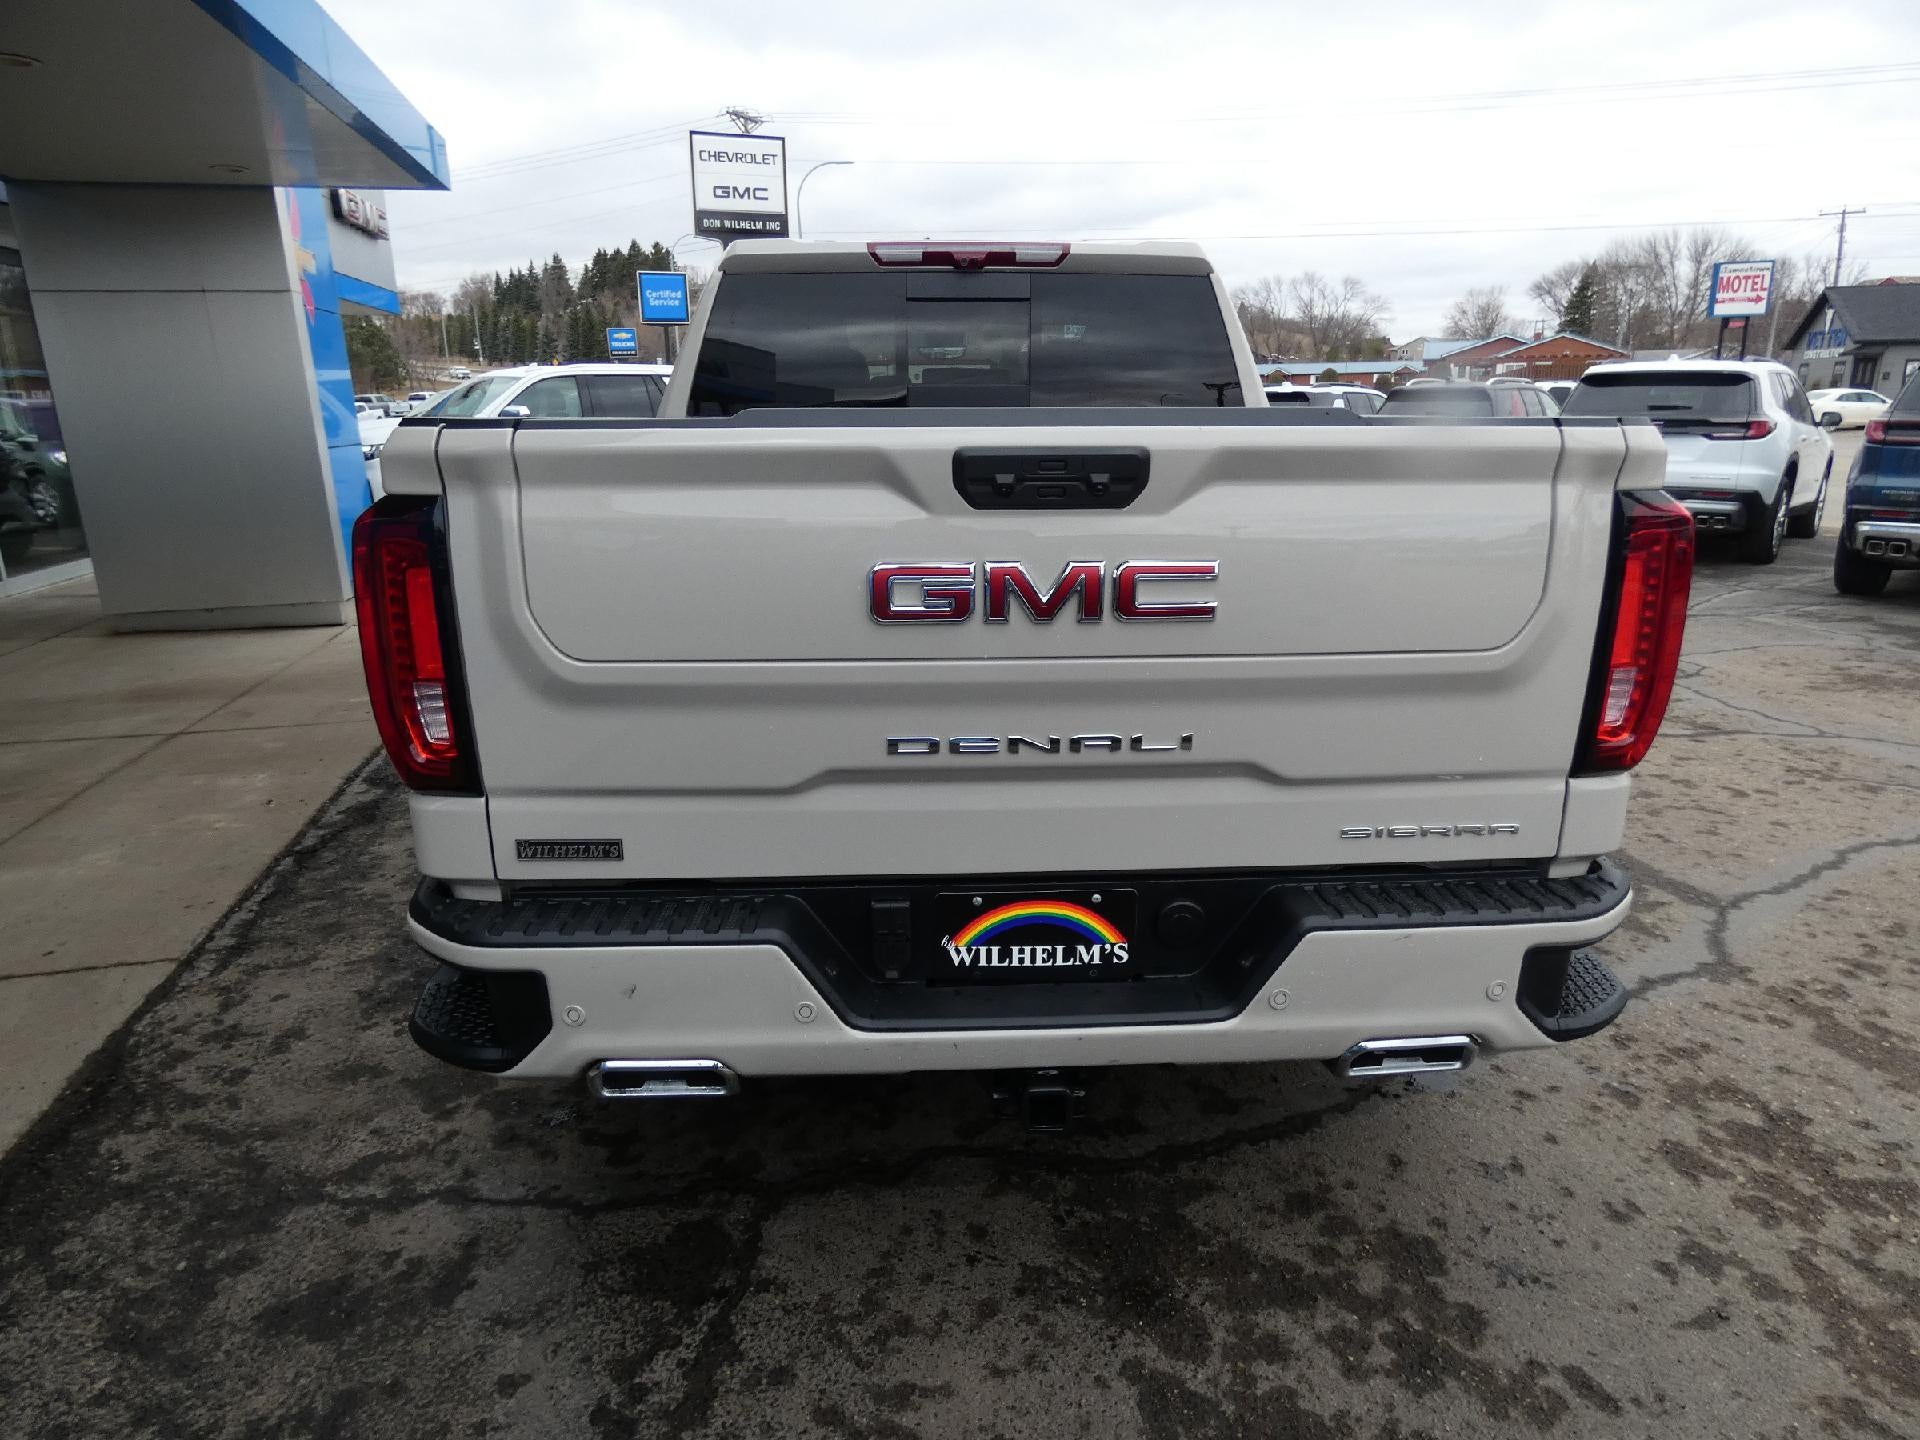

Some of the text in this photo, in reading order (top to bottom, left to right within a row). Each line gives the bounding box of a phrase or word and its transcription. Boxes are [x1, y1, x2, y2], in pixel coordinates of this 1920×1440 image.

[698, 149, 778, 165] CHEVROLET
[713, 185, 769, 201] GMC
[703, 218, 781, 231] DON WILHELM INC
[1717, 274, 1768, 294] MOTEL
[645, 289, 682, 299] Certified
[649, 298, 680, 307] Service
[868, 560, 1220, 625] GMC
[886, 732, 1194, 755] DENALI
[1341, 823, 1520, 838] SIERRA
[519, 844, 619, 858] WILHELM'S
[949, 942, 1129, 968] WILHELM'S
